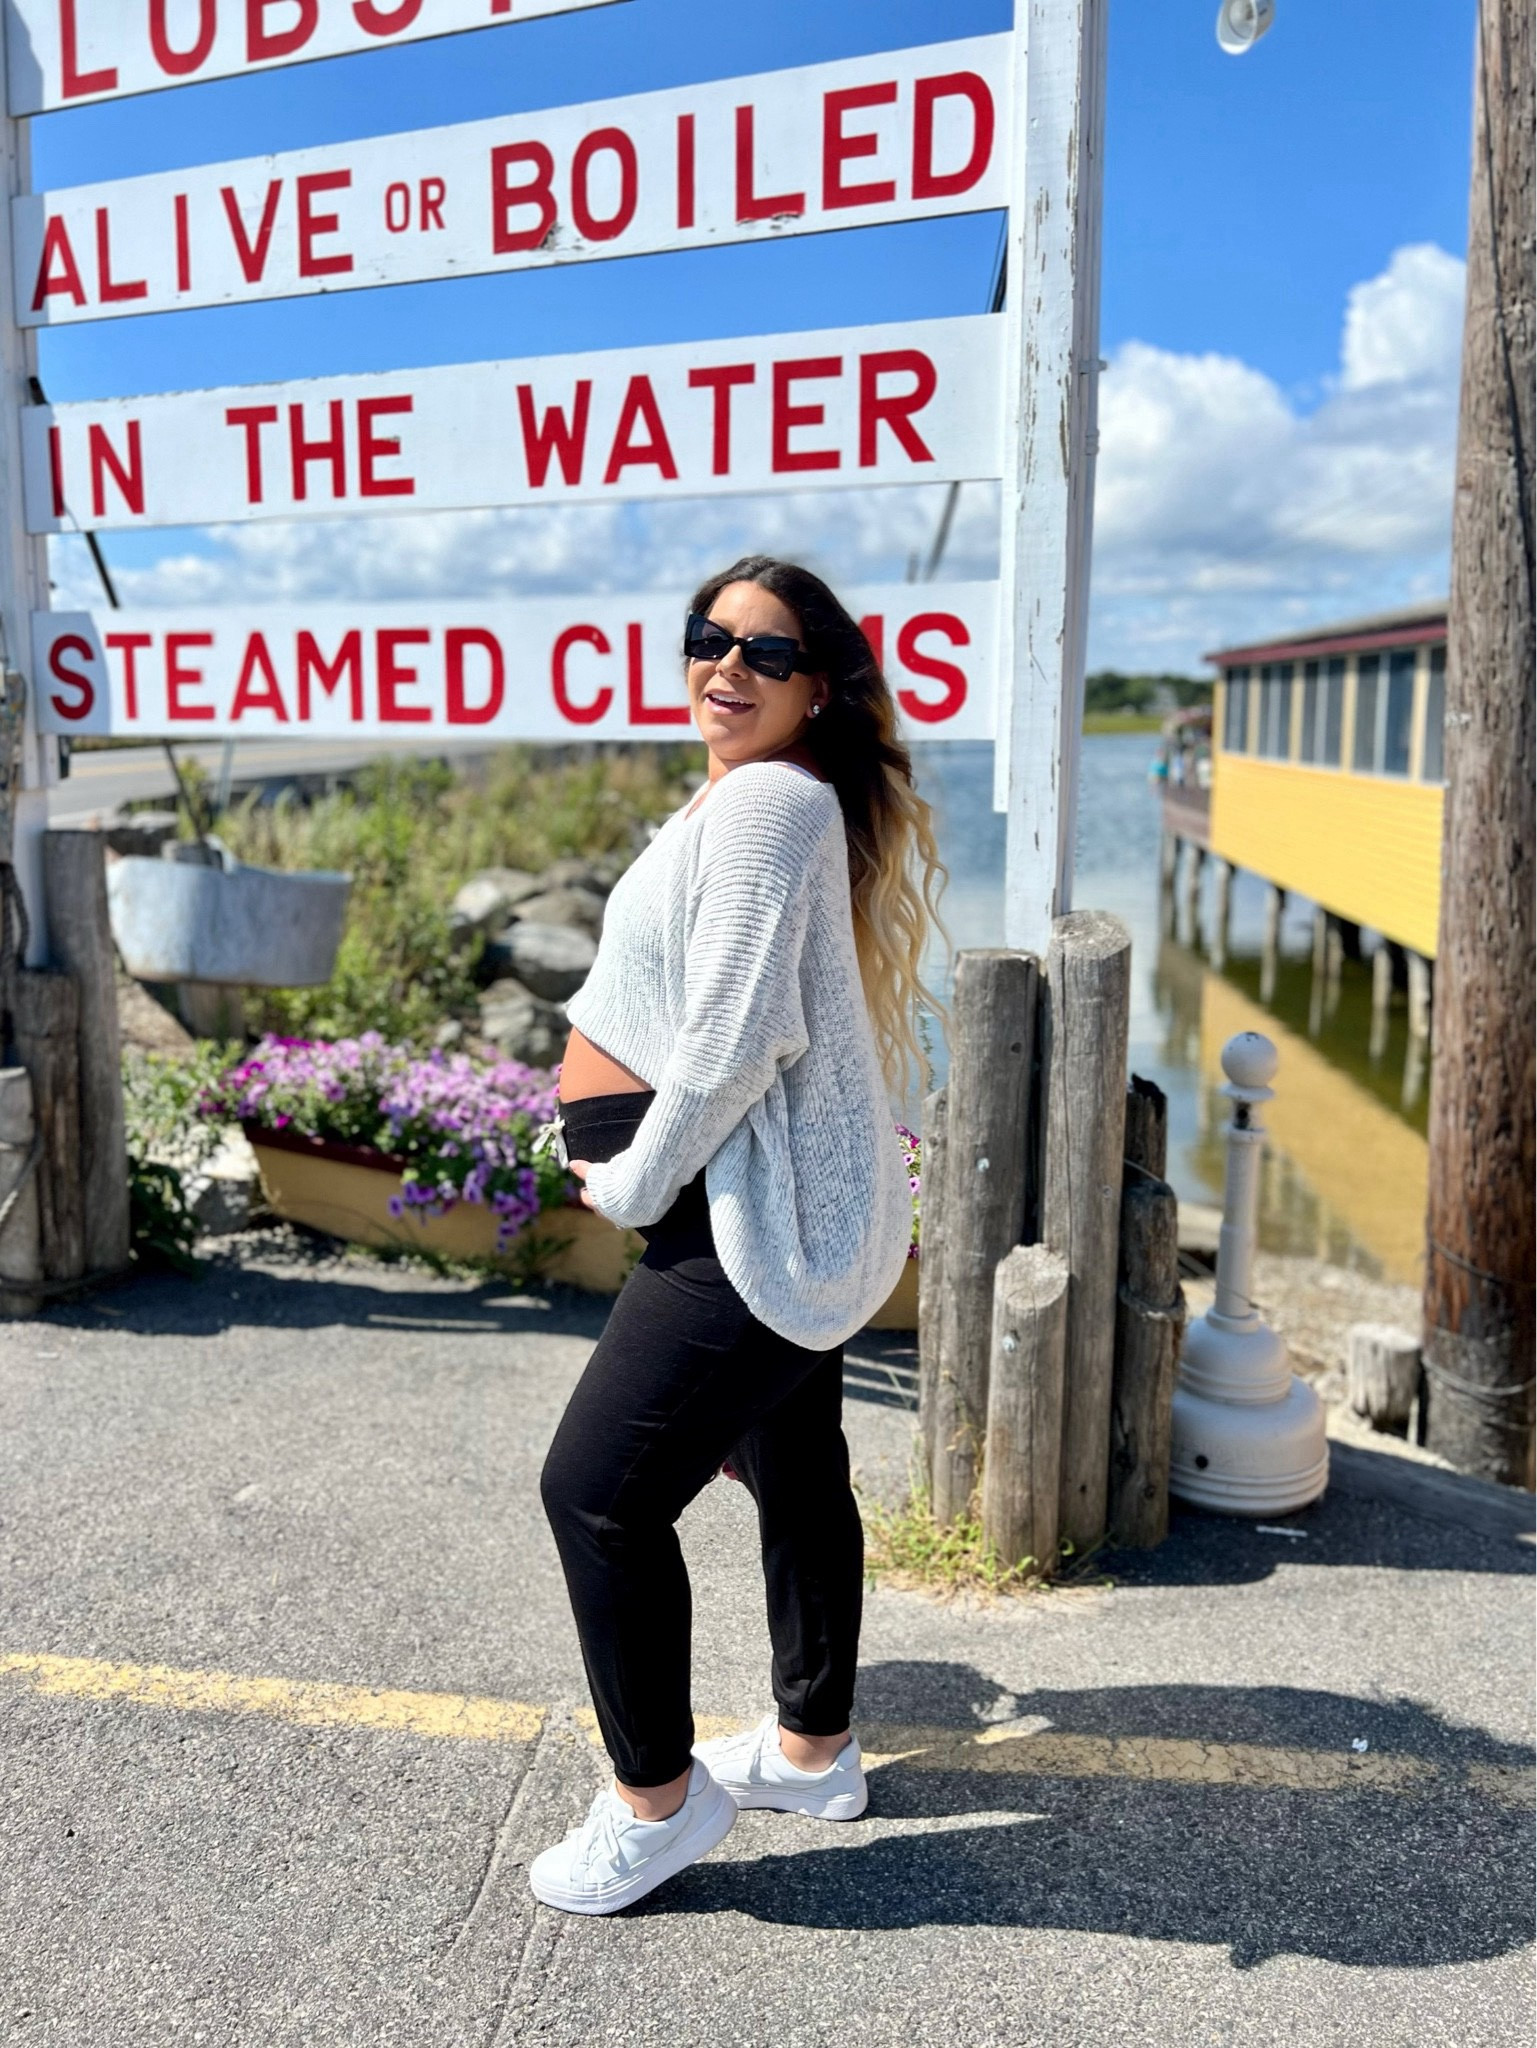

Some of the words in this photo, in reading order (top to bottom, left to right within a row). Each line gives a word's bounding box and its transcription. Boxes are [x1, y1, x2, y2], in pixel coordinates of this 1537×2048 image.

[32, 169, 354, 311] ALIVE
[384, 177, 447, 233] OR
[491, 71, 995, 255] BOILED
[49, 420, 145, 518] IN
[225, 394, 415, 504] THE
[517, 349, 938, 490] WATER
[50, 627, 506, 726] STEAMED
[551, 612, 971, 726] CLS
